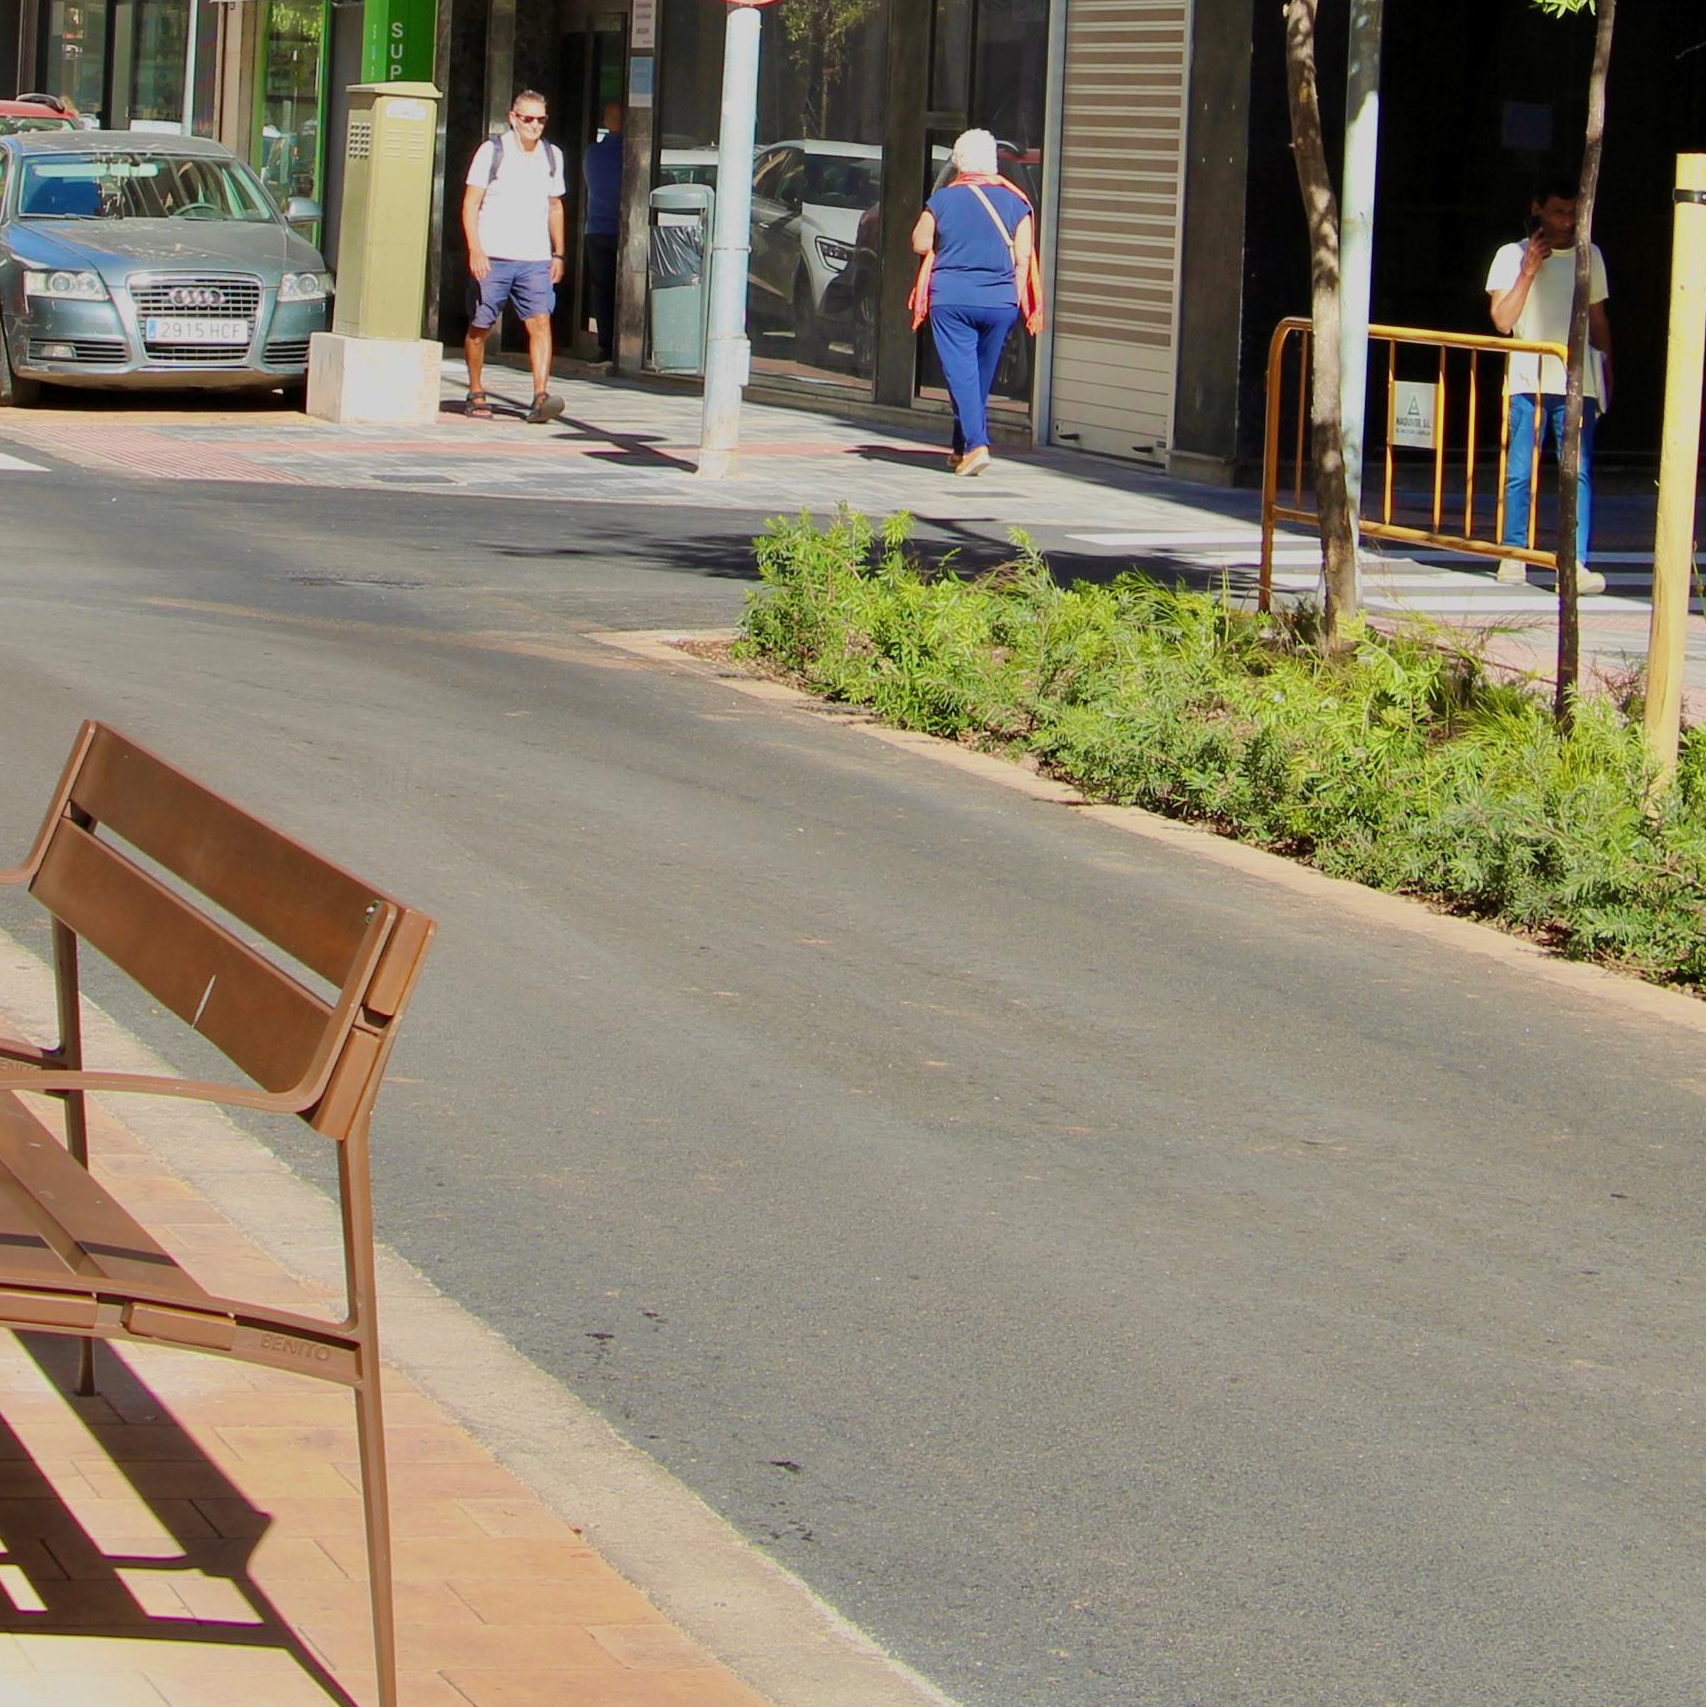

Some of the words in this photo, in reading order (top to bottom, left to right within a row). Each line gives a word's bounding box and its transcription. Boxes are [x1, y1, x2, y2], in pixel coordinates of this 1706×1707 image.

[161, 322, 205, 339] 2915
[209, 322, 242, 339] HCF
[260, 1333, 331, 1361] BENITO
